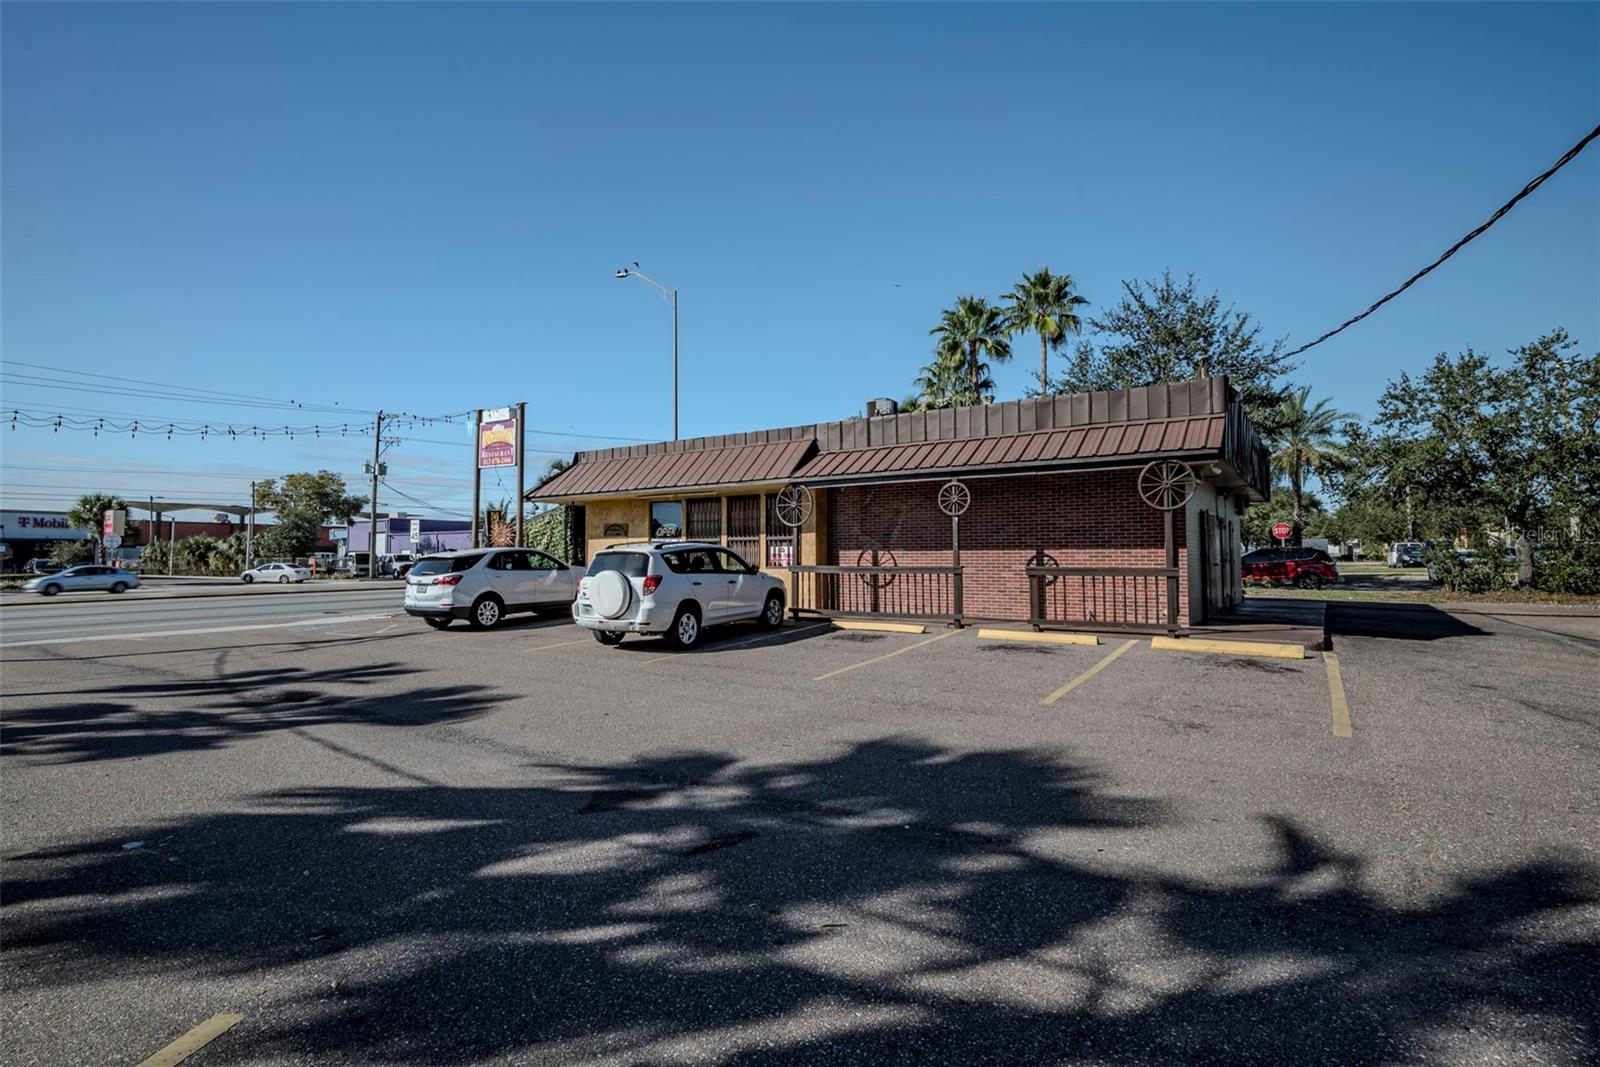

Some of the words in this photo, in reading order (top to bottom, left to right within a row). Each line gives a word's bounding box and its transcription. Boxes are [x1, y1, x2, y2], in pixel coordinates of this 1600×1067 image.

[32, 517, 71, 529] Mobil
[656, 527, 681, 537] OPEN
[1273, 527, 1290, 535] STOP
